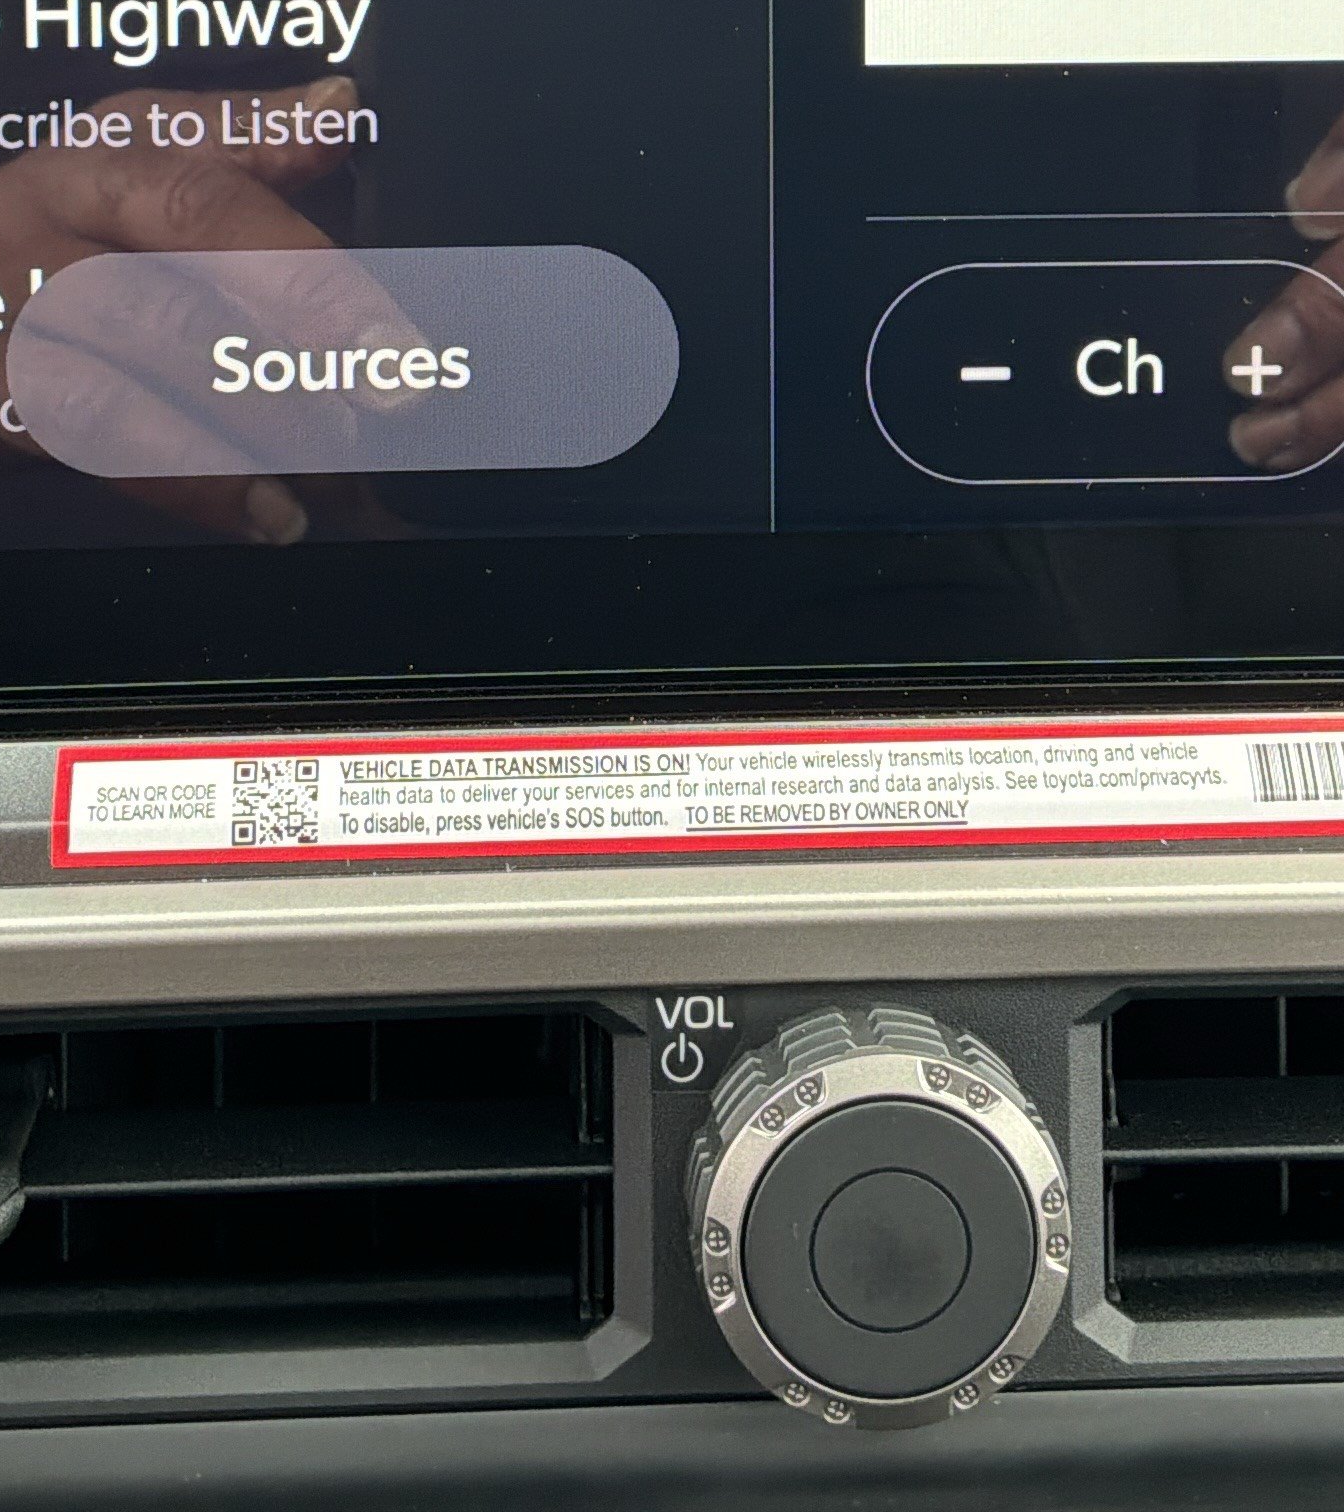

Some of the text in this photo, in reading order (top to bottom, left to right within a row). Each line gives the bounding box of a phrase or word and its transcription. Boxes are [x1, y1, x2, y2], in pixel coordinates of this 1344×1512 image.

[146, 103, 205, 147] to
[221, 97, 378, 146] Listen
[212, 336, 471, 393] Sources
[1076, 337, 1164, 396] Ch
[340, 759, 423, 779] VEHICLE
[430, 758, 478, 777] DATA
[483, 755, 627, 776] TRANSMISSION
[634, 754, 651, 772] IS
[696, 752, 733, 772] Your
[739, 750, 797, 770] vehicle
[802, 750, 883, 772] wirelessly
[888, 747, 964, 767] transmits
[969, 746, 1039, 766] location,
[1044, 744, 1098, 767] driving
[1104, 743, 1134, 762] and
[1140, 741, 1198, 760] vehicle
[97, 784, 216, 803] SCAN QR CODE
[339, 786, 390, 806] health
[397, 786, 433, 804] data
[440, 786, 455, 803] to
[462, 784, 516, 803] deliver
[523, 786, 559, 806] your
[565, 781, 634, 801] services
[640, 779, 671, 798] and
[677, 779, 699, 797] for
[704, 777, 765, 796] internal
[771, 776, 843, 795] research
[849, 775, 879, 793] and
[885, 773, 921, 792] data
[927, 771, 1000, 795] analysis.
[1005, 771, 1038, 789] See
[88, 802, 216, 821] TO LEARN MORE
[339, 800, 969, 835] To disable, press vehicle's SOS button. TO BE REMOVED BY OWNER ONLY
[655, 995, 734, 1030] VOL
